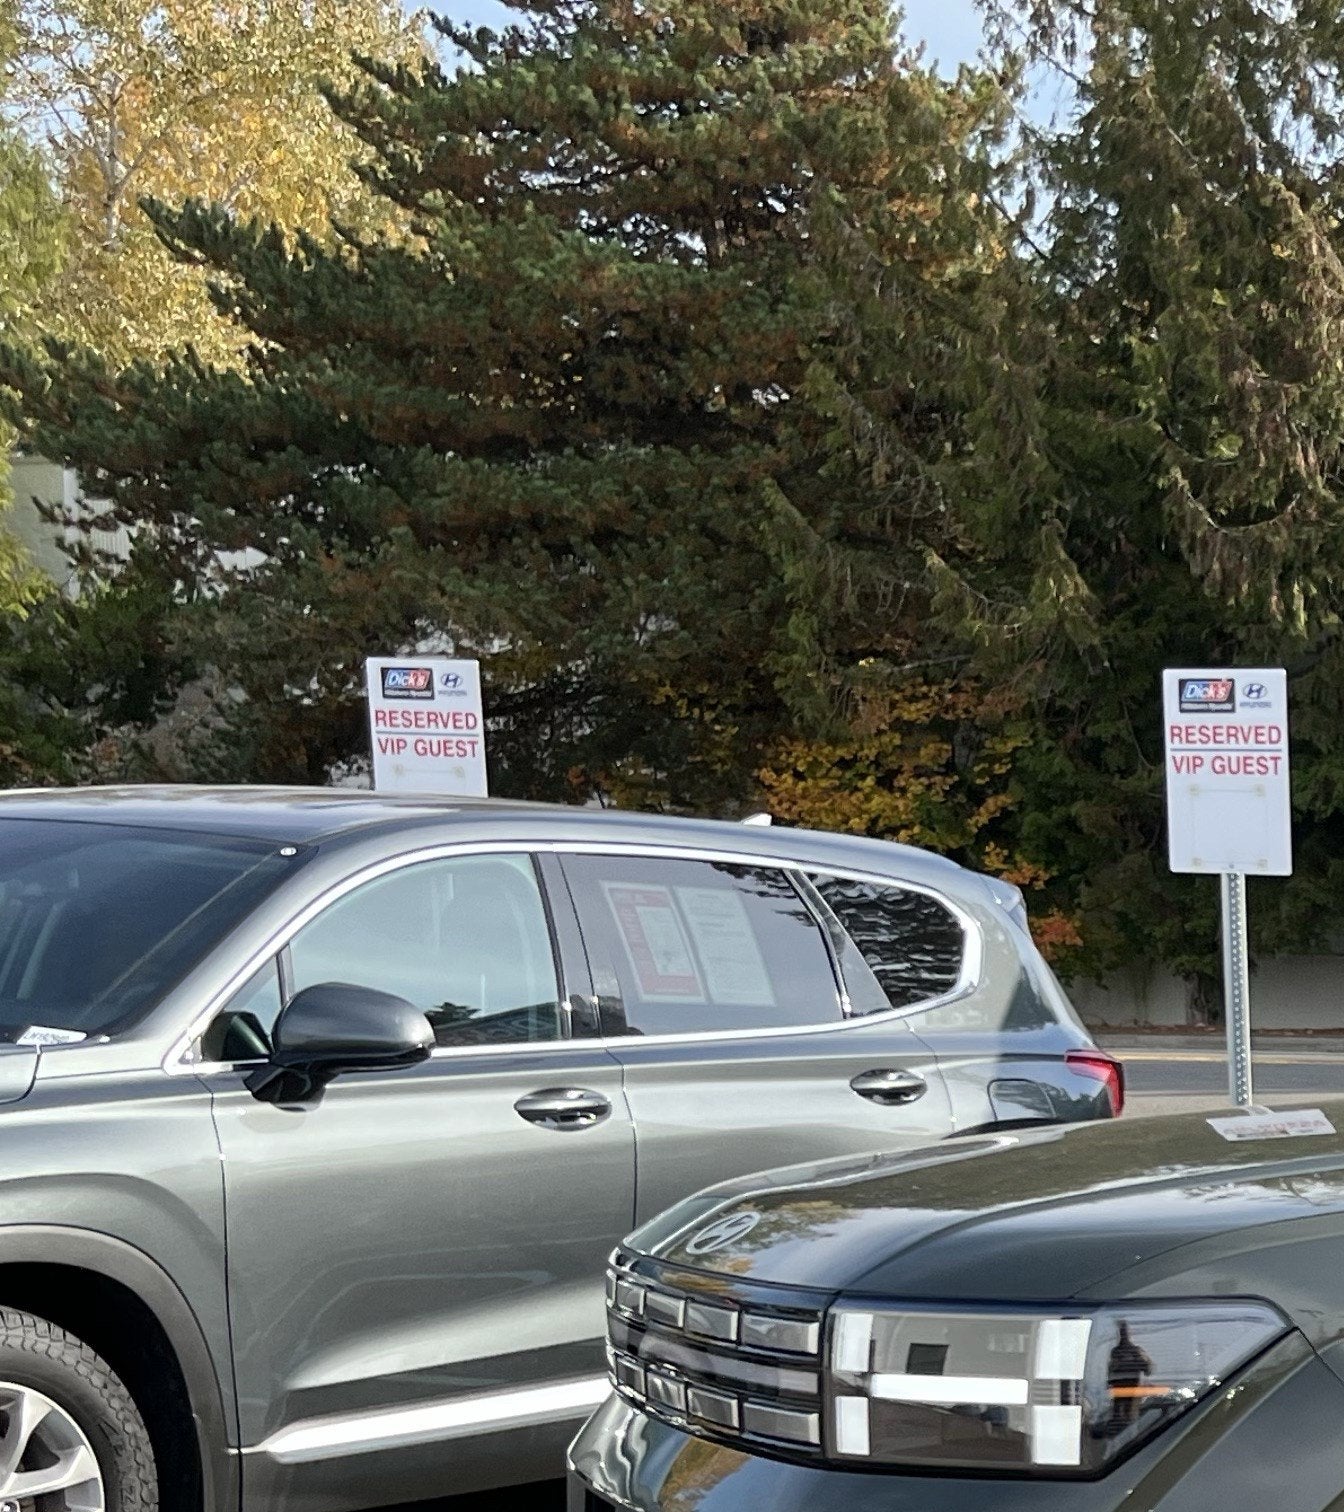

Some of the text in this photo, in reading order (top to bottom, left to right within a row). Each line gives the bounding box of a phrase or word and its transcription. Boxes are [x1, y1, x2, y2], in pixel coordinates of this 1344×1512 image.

[374, 709, 478, 730] RESERVED
[1170, 725, 1282, 745] RESERVED
[377, 737, 479, 758] VIP GUEST
[1171, 755, 1282, 775] VIP GUEST
